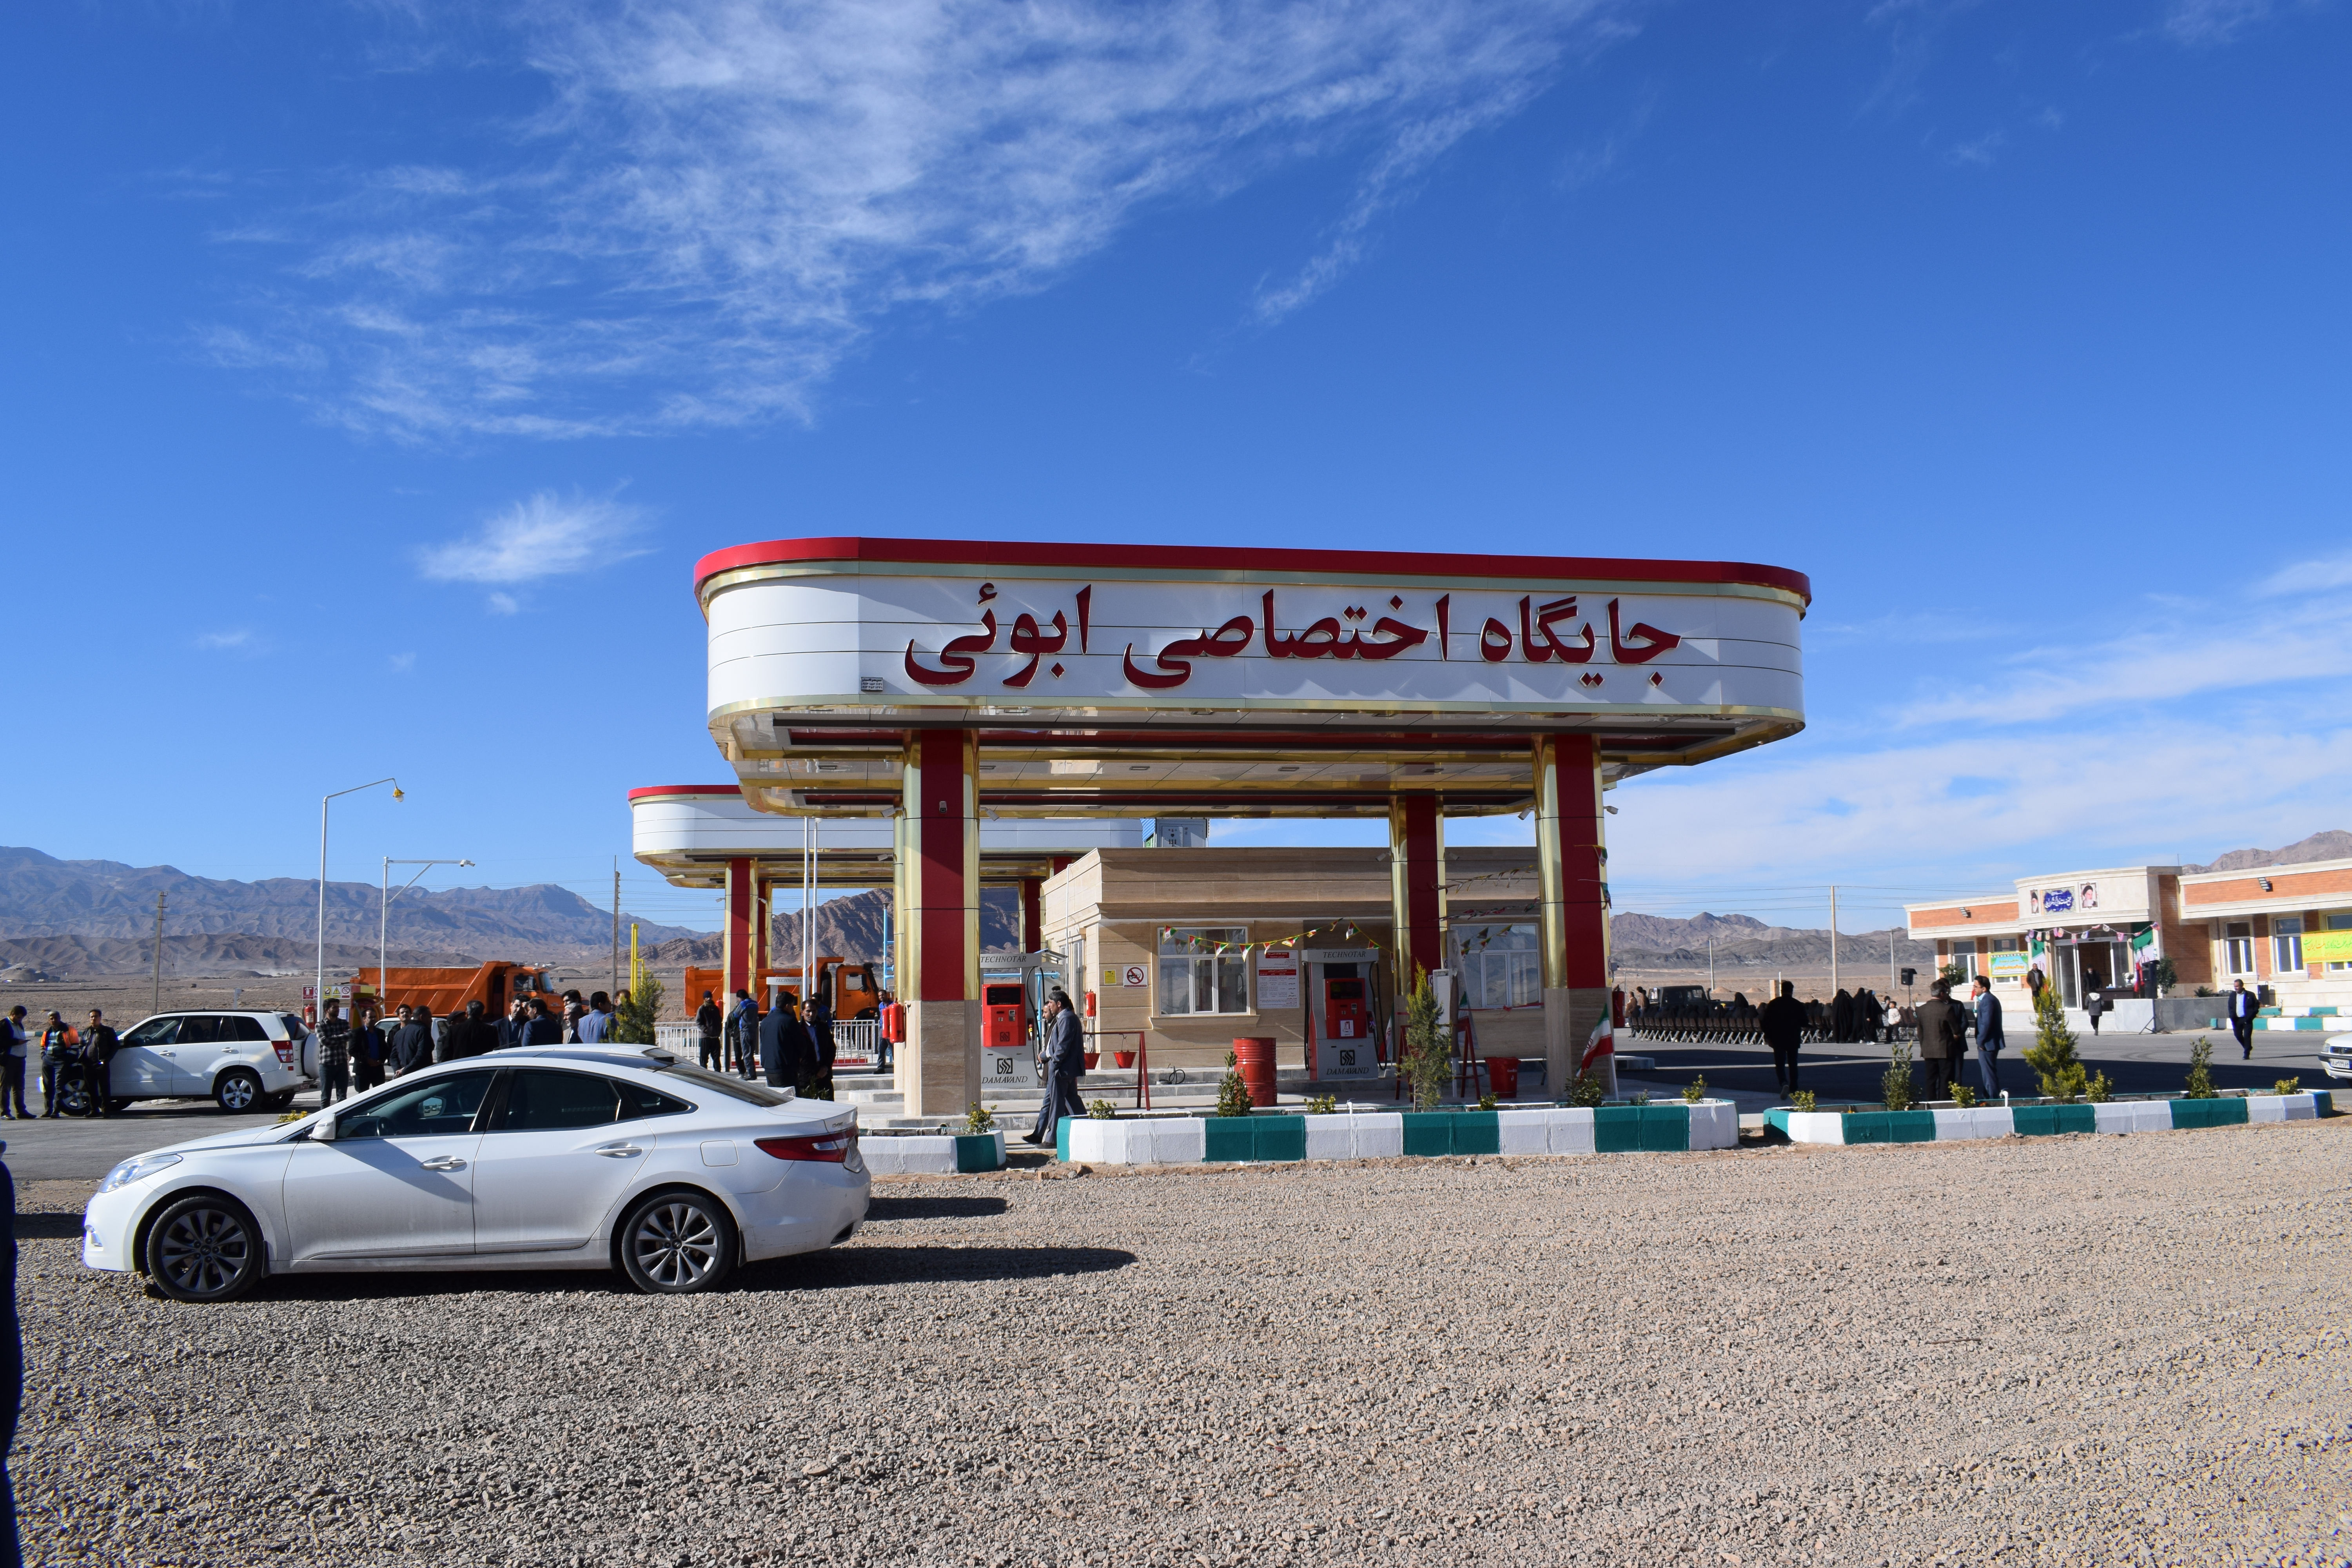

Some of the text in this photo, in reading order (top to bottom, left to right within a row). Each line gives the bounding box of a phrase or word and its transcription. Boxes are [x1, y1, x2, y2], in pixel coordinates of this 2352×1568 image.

[904, 583, 1682, 689] جایگاه اختصاصی ابوئی
